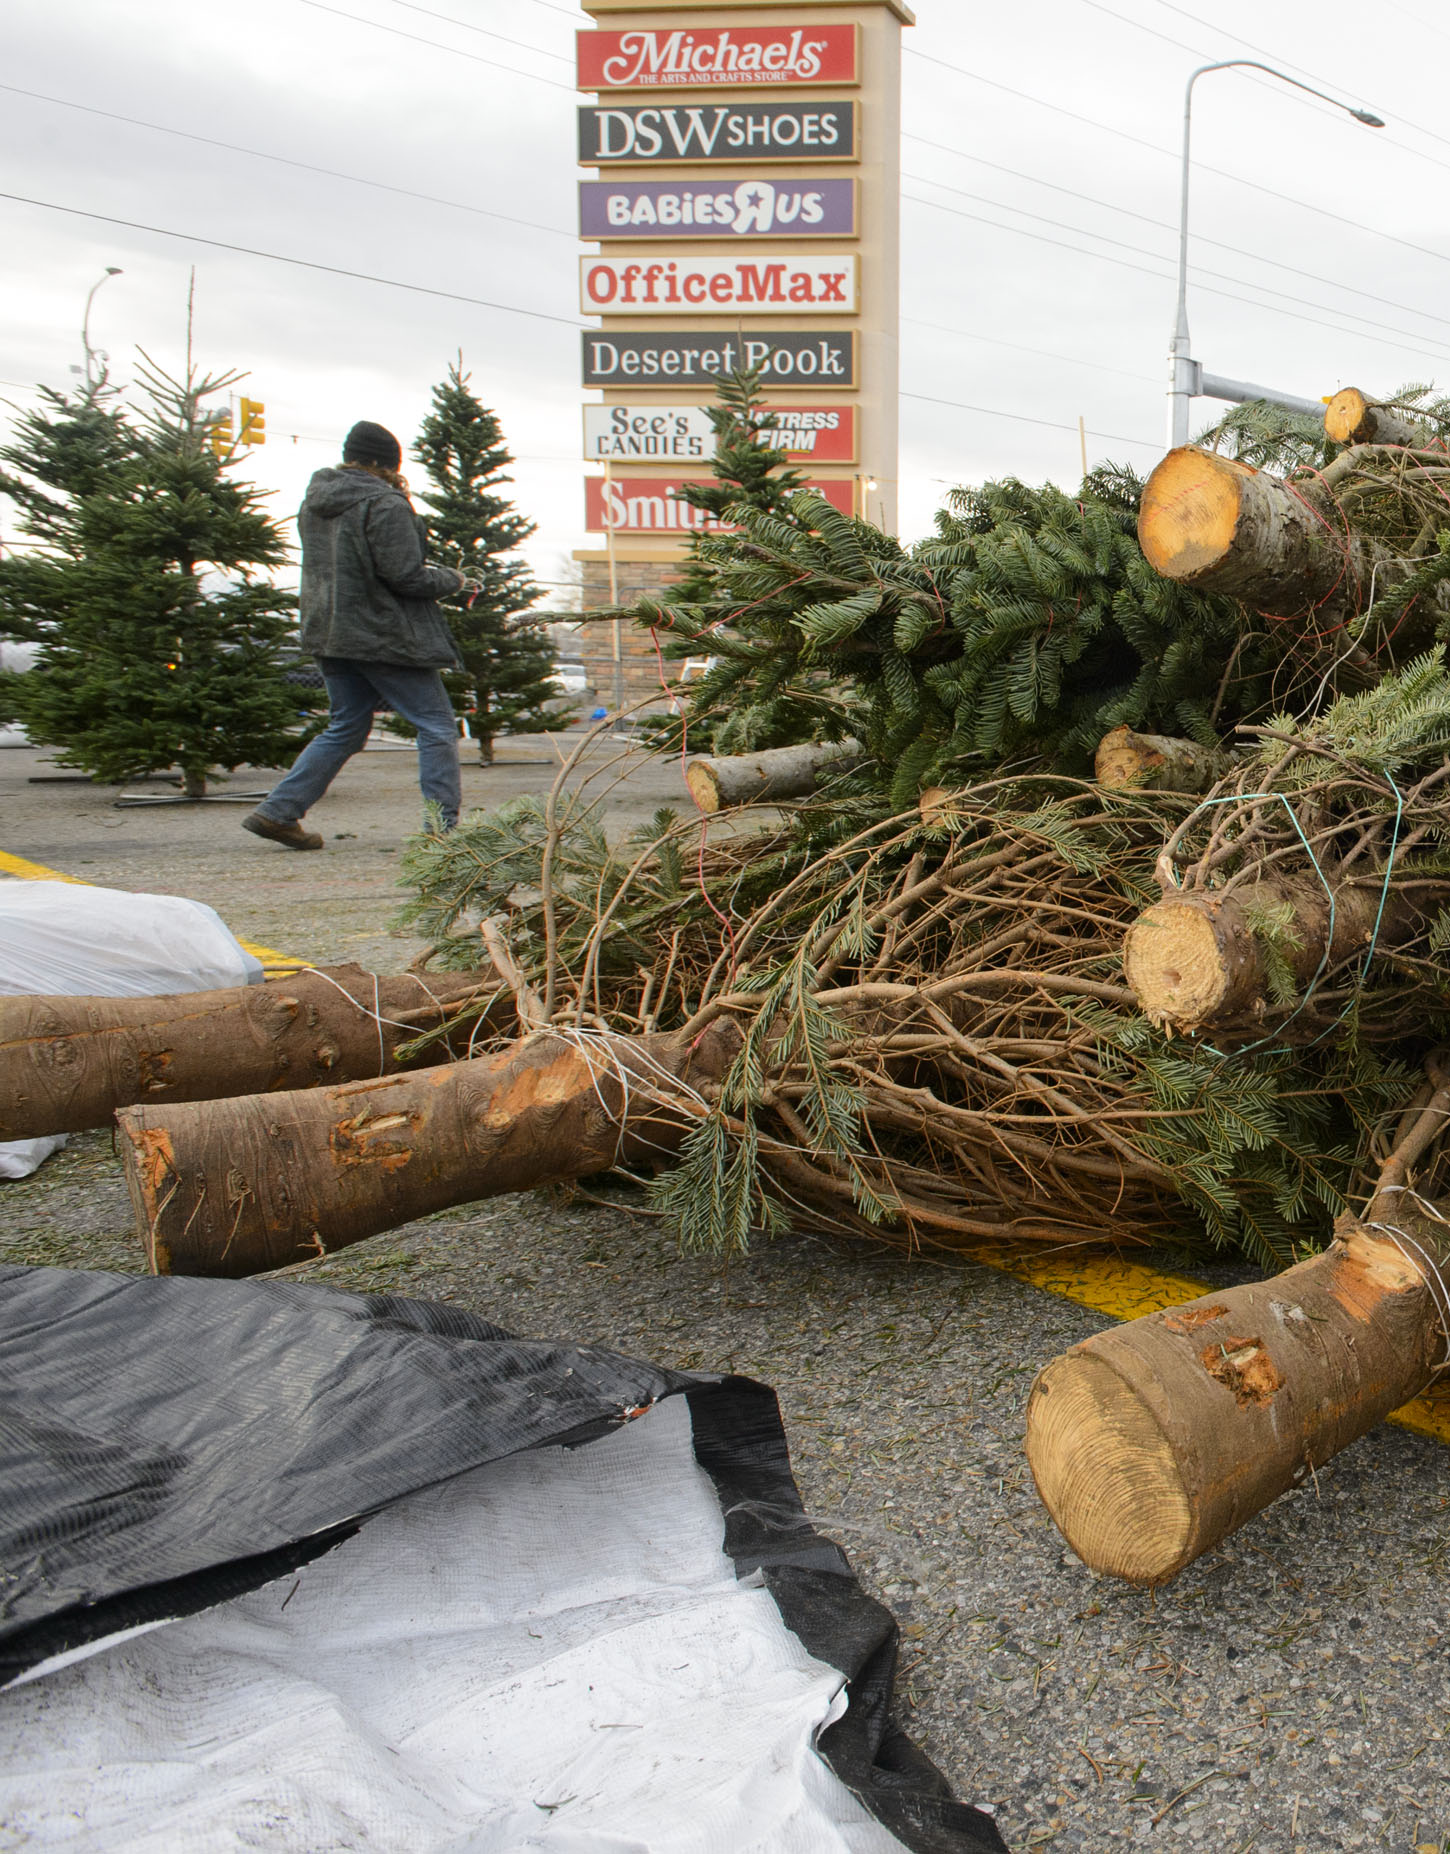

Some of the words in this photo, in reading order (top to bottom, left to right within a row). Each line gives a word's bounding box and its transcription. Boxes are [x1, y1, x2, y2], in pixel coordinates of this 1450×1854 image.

[602, 29, 824, 86] Michaels
[638, 73, 658, 84] THE
[660, 73, 687, 83] ARTS
[688, 72, 711, 83] AND
[712, 71, 751, 82] CRAFTS
[754, 70, 788, 81] STORE
[594, 108, 729, 158] DSW
[726, 113, 839, 146] SHOES
[586, 262, 848, 304] OfficeMax
[590, 341, 737, 375] Deseret
[743, 341, 845, 375] Book
[611, 406, 690, 435] See's
[596, 435, 704, 456] CANDIES
[755, 429, 818, 451] FIRM
